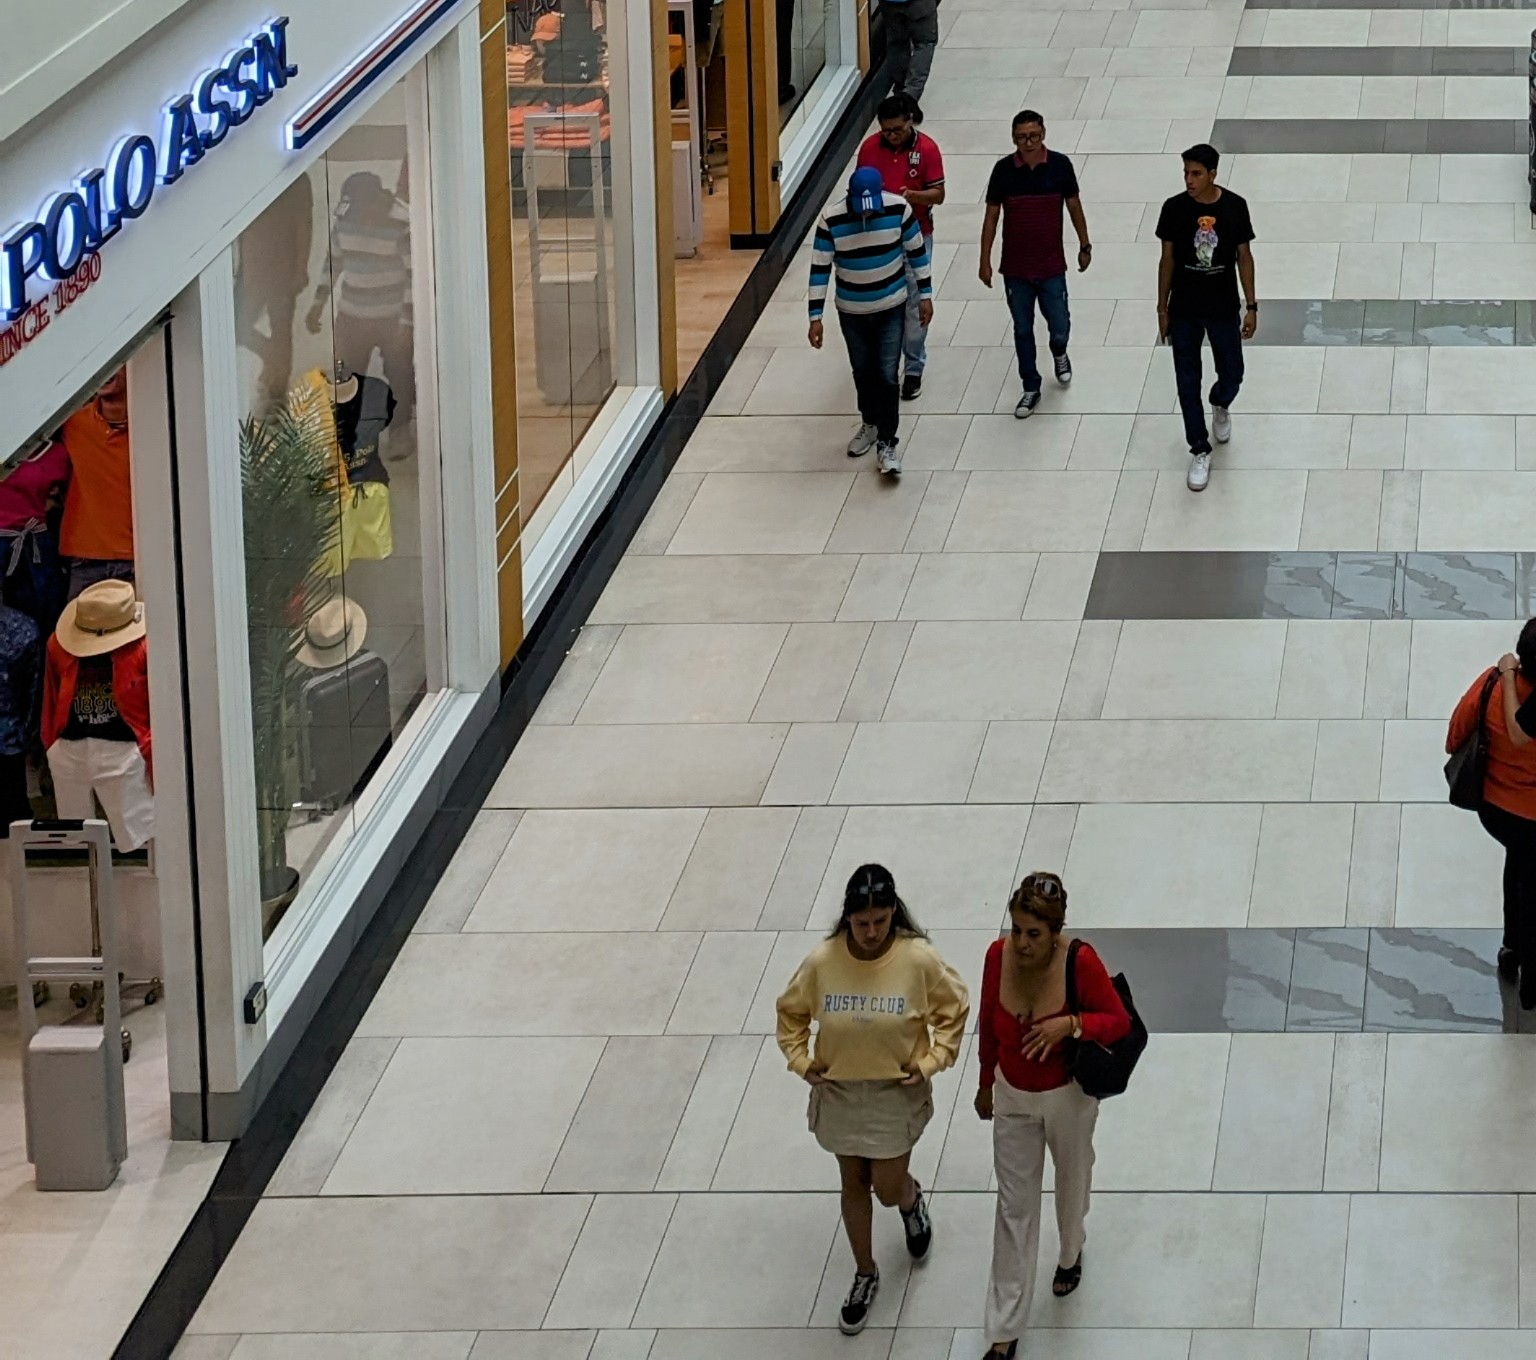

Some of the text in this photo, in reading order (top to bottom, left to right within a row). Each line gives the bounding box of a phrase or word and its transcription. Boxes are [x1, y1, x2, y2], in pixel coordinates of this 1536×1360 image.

[0, 135, 158, 321] POLO
[53, 251, 101, 315] 1890
[824, 994, 905, 1015] RUSTY CLUB
